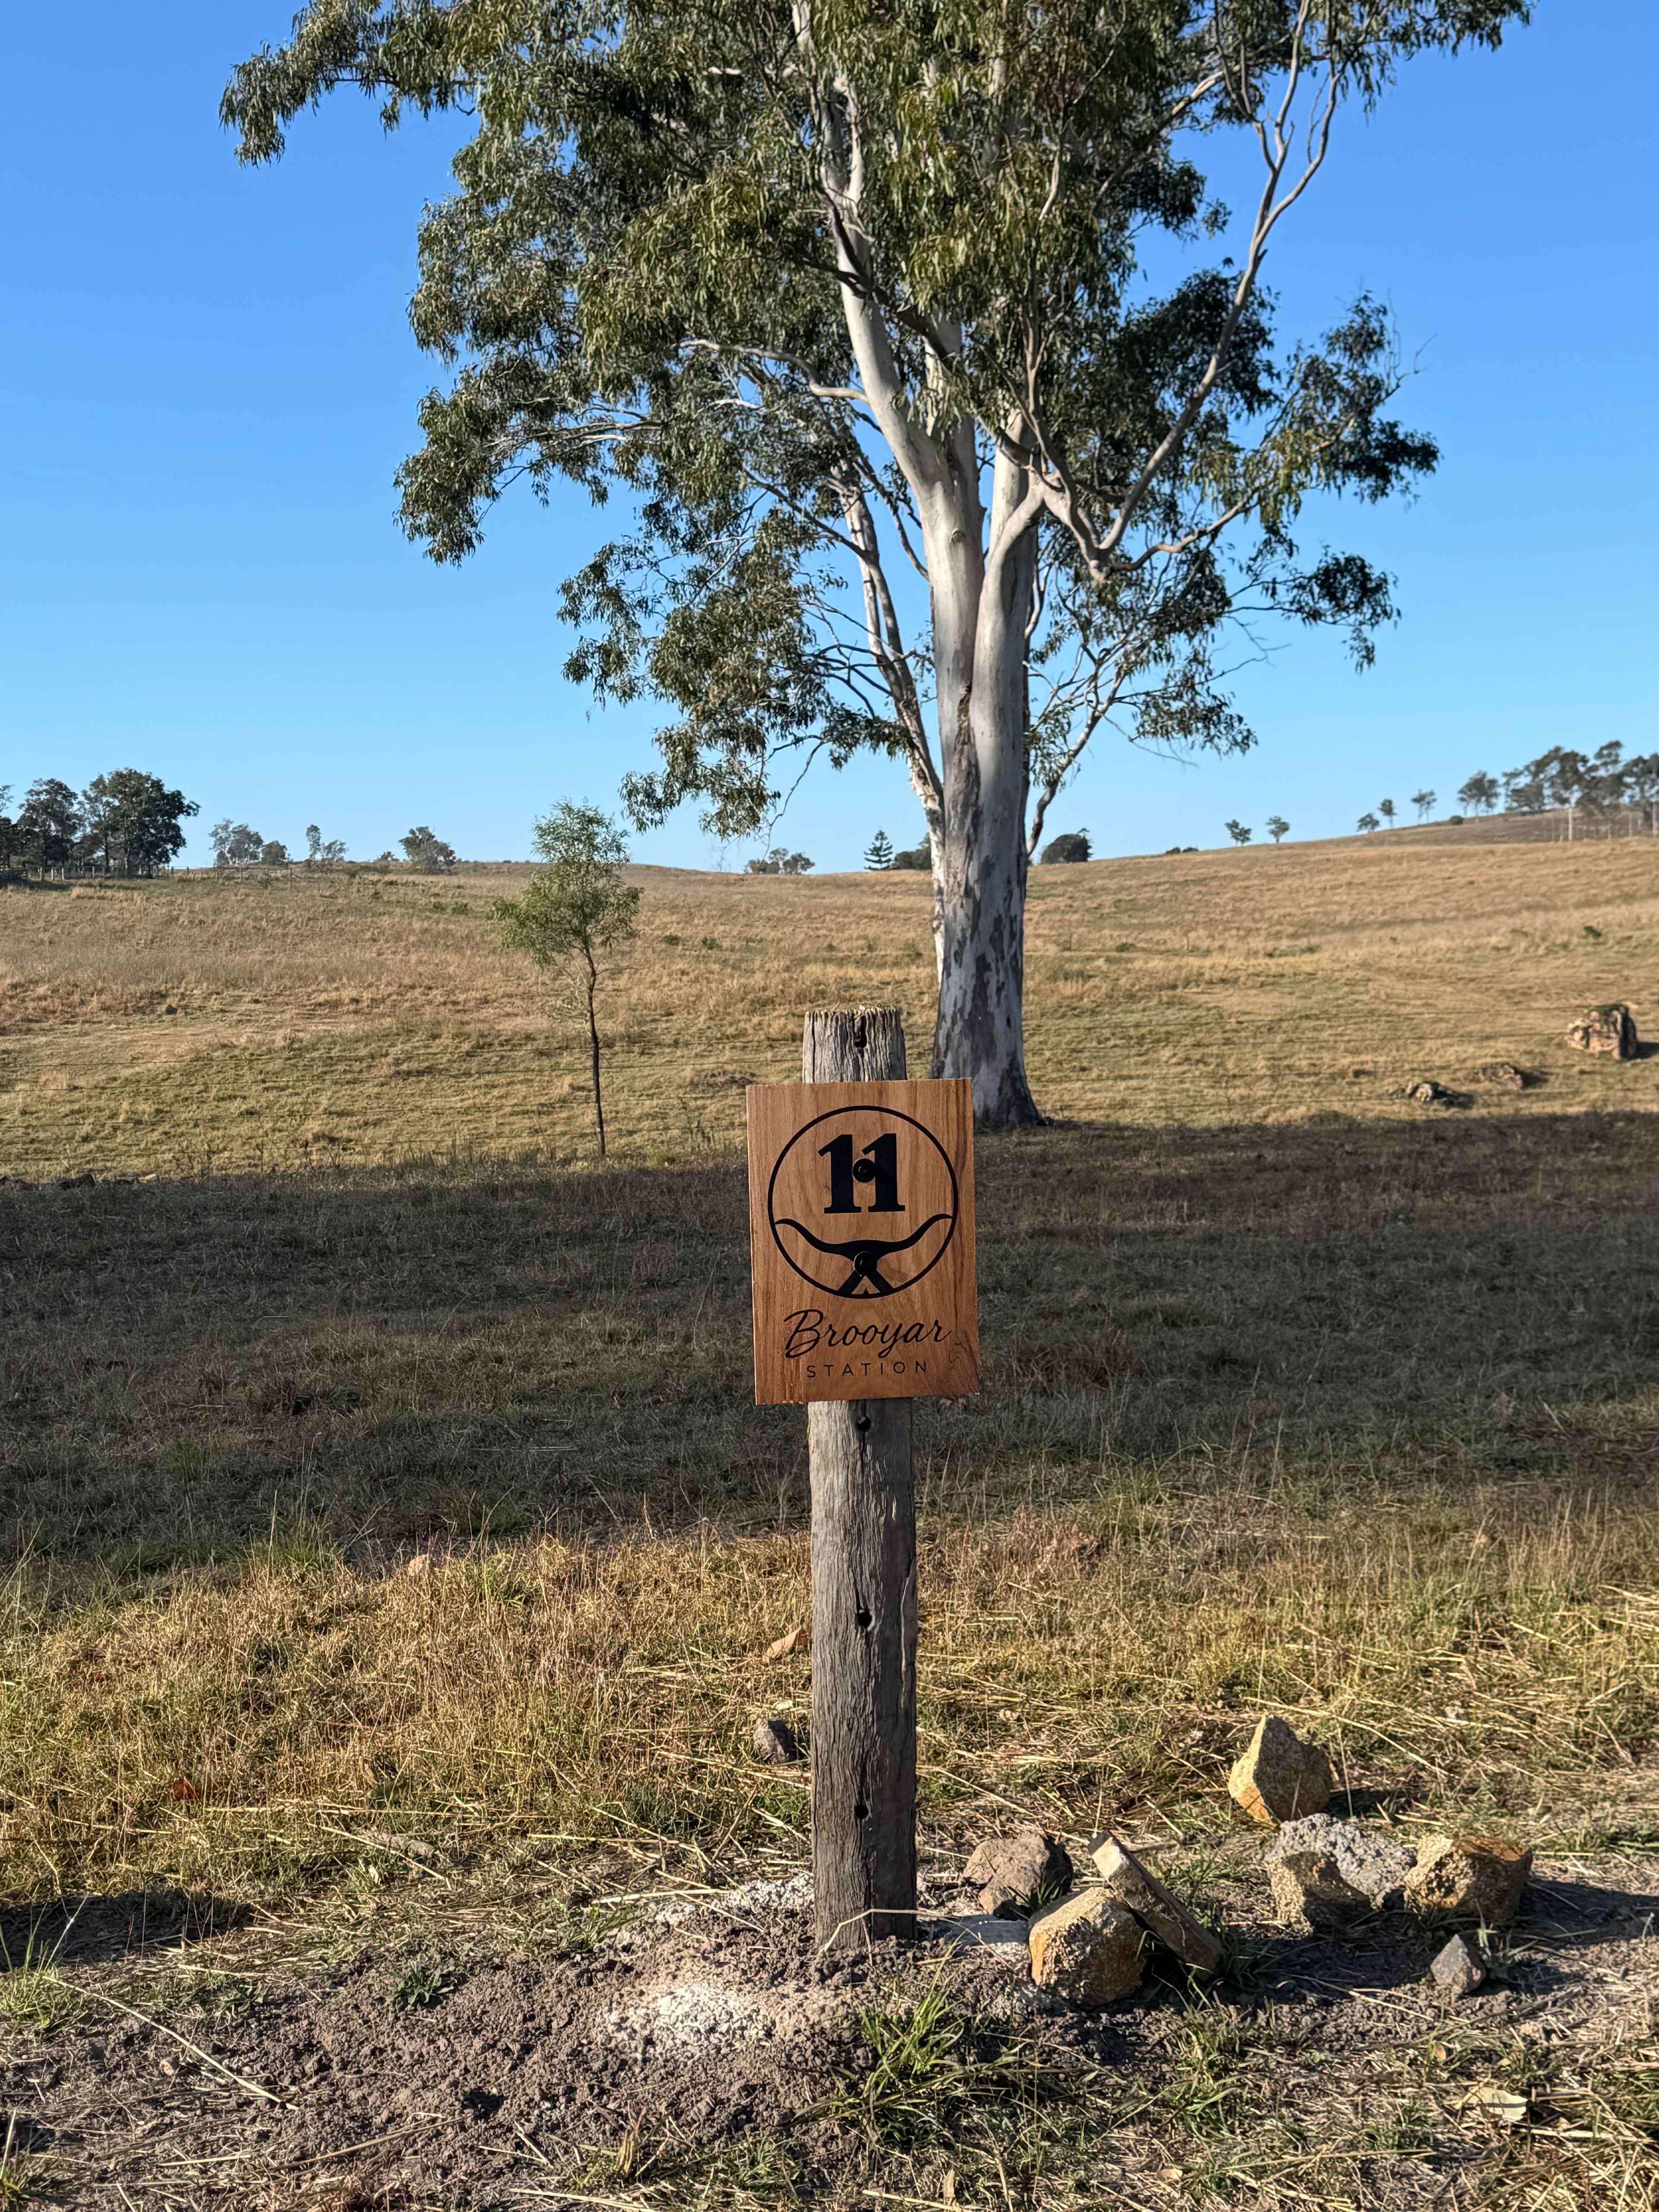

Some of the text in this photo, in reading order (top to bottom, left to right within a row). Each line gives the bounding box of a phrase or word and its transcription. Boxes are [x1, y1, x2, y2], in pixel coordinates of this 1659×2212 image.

[818, 1133, 906, 1214] 11
[784, 1309, 952, 1358] Brooyar
[807, 1361, 926, 1378] STATION
